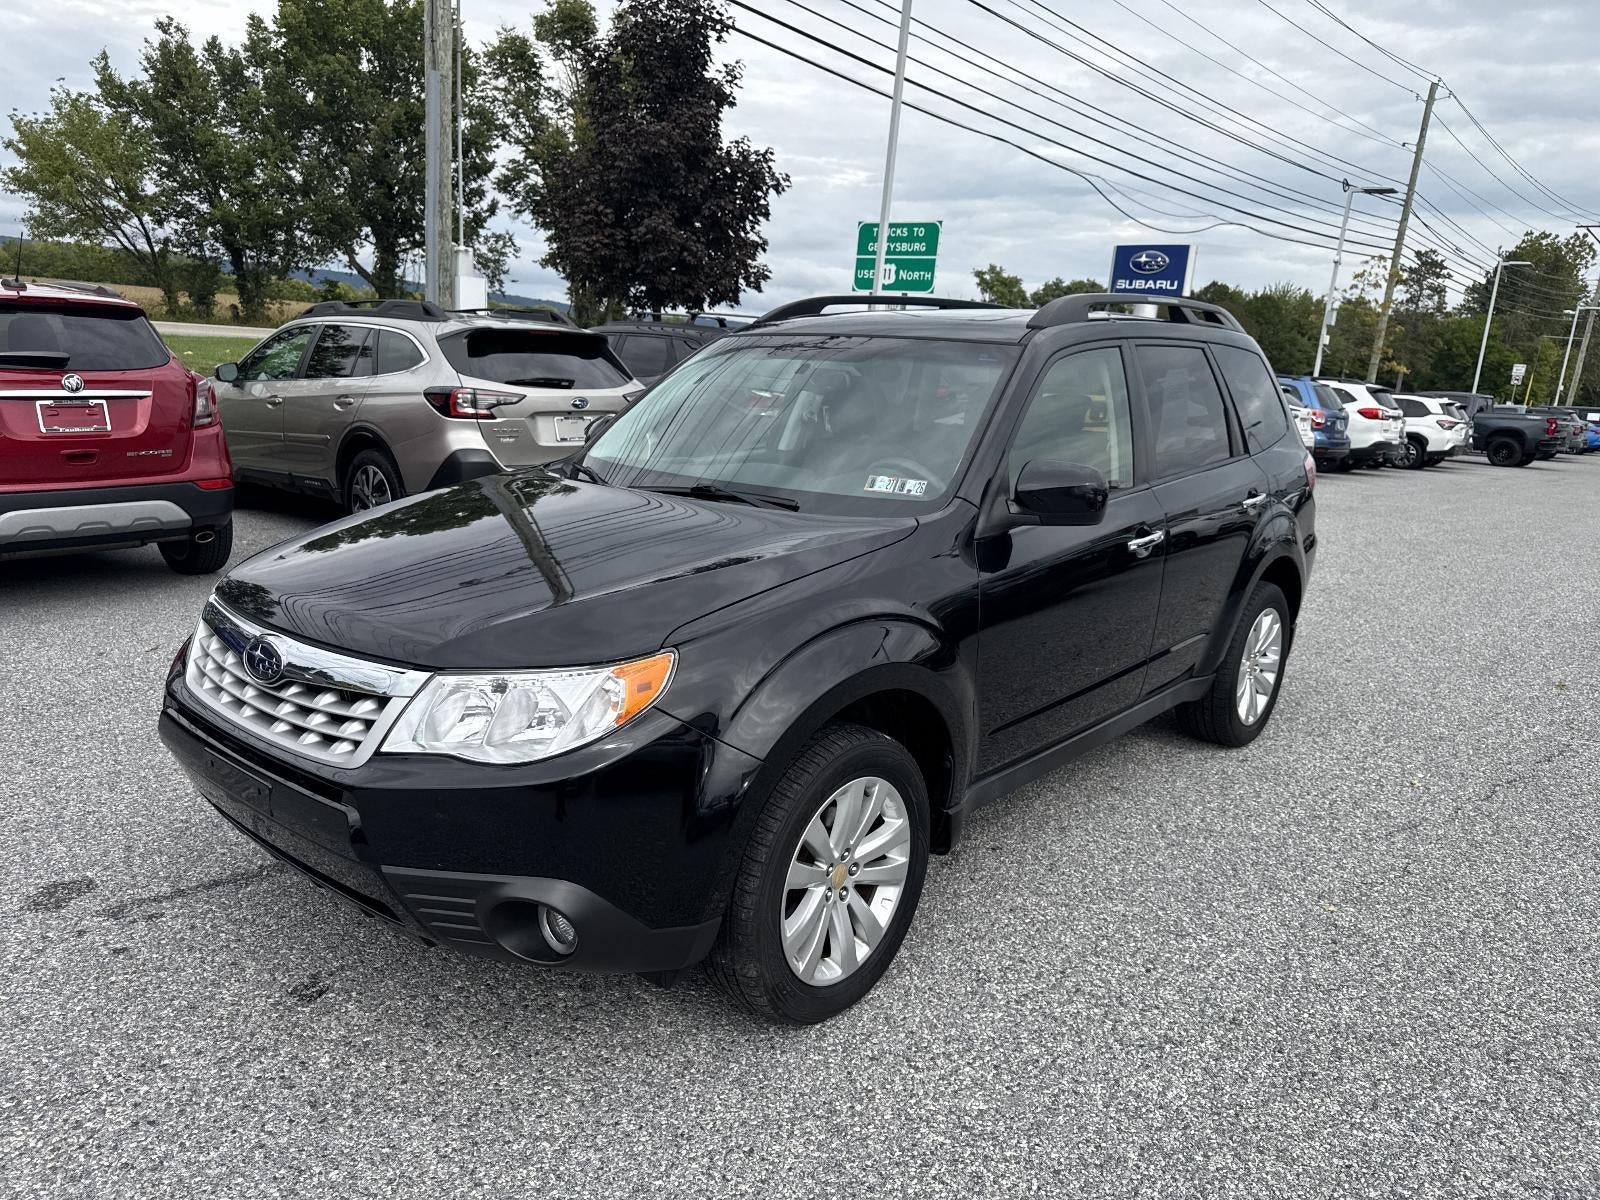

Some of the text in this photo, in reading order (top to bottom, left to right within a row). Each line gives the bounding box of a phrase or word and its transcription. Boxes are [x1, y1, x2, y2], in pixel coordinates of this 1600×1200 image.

[873, 227, 925, 237] TCKS TO
[868, 242, 926, 252] GEYSBURG
[857, 269, 875, 279] USE
[899, 269, 932, 281] NORTH
[1116, 279, 1178, 290] SUBARU
